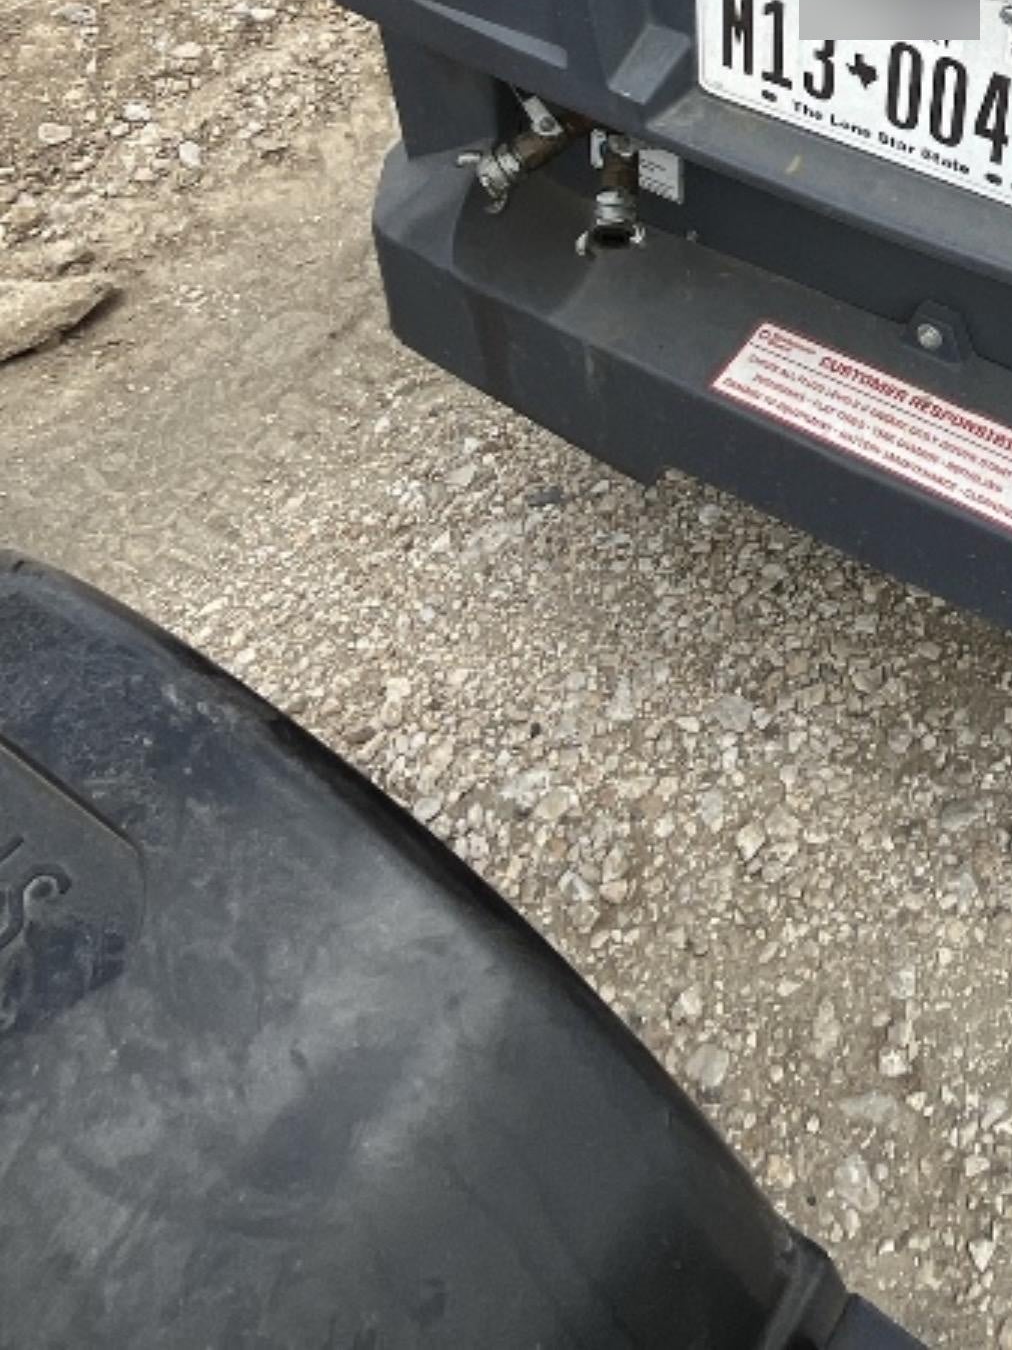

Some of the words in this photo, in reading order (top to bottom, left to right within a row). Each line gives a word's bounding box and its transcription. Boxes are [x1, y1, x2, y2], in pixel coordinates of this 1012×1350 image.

[793, 100, 824, 121] The
[830, 113, 872, 139] Lone
[878, 130, 916, 154] Star
[920, 147, 971, 175] State
[819, 355, 909, 404] CUSTOMER
